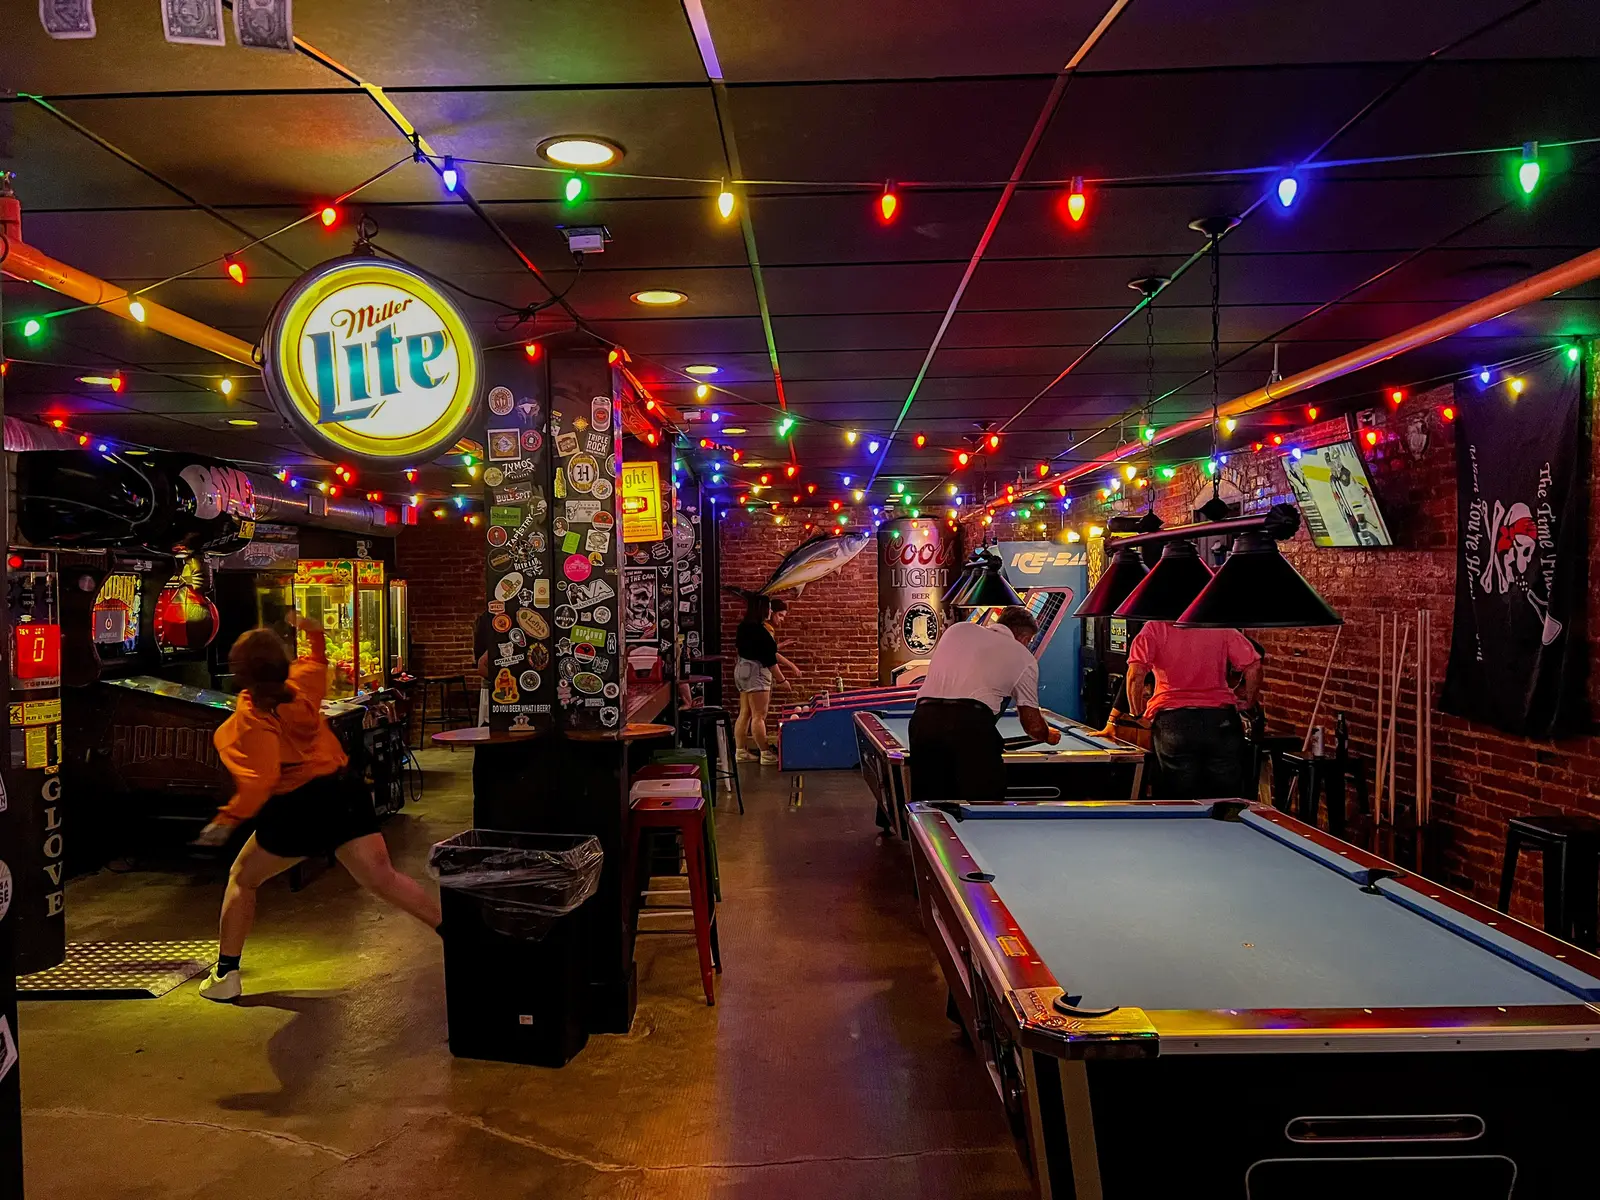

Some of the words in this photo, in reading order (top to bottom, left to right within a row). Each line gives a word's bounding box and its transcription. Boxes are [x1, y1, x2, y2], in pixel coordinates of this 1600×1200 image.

[331, 298, 413, 339] Miller
[306, 322, 451, 425] Lite
[586, 441, 607, 453] ROCK
[588, 433, 609, 444] TRIPLE
[502, 458, 535, 478] ZYMOS
[576, 465, 589, 482] H
[1537, 462, 1553, 498] The
[496, 493, 514, 503] BULL
[515, 490, 531, 500] SPIT
[1465, 498, 1484, 551] You're
[1536, 502, 1557, 549] Time
[883, 536, 955, 566] Coors
[630, 574, 641, 582] THE
[891, 567, 950, 588] LIGHT
[33, 637, 45, 662] 0
[492, 705, 499, 713] DO
[499, 705, 509, 713] YOU
[509, 705, 521, 713] BEER
[521, 704, 534, 712] WHAT
[537, 704, 551, 712] BEER?
[41, 778, 64, 917] GLOVE
